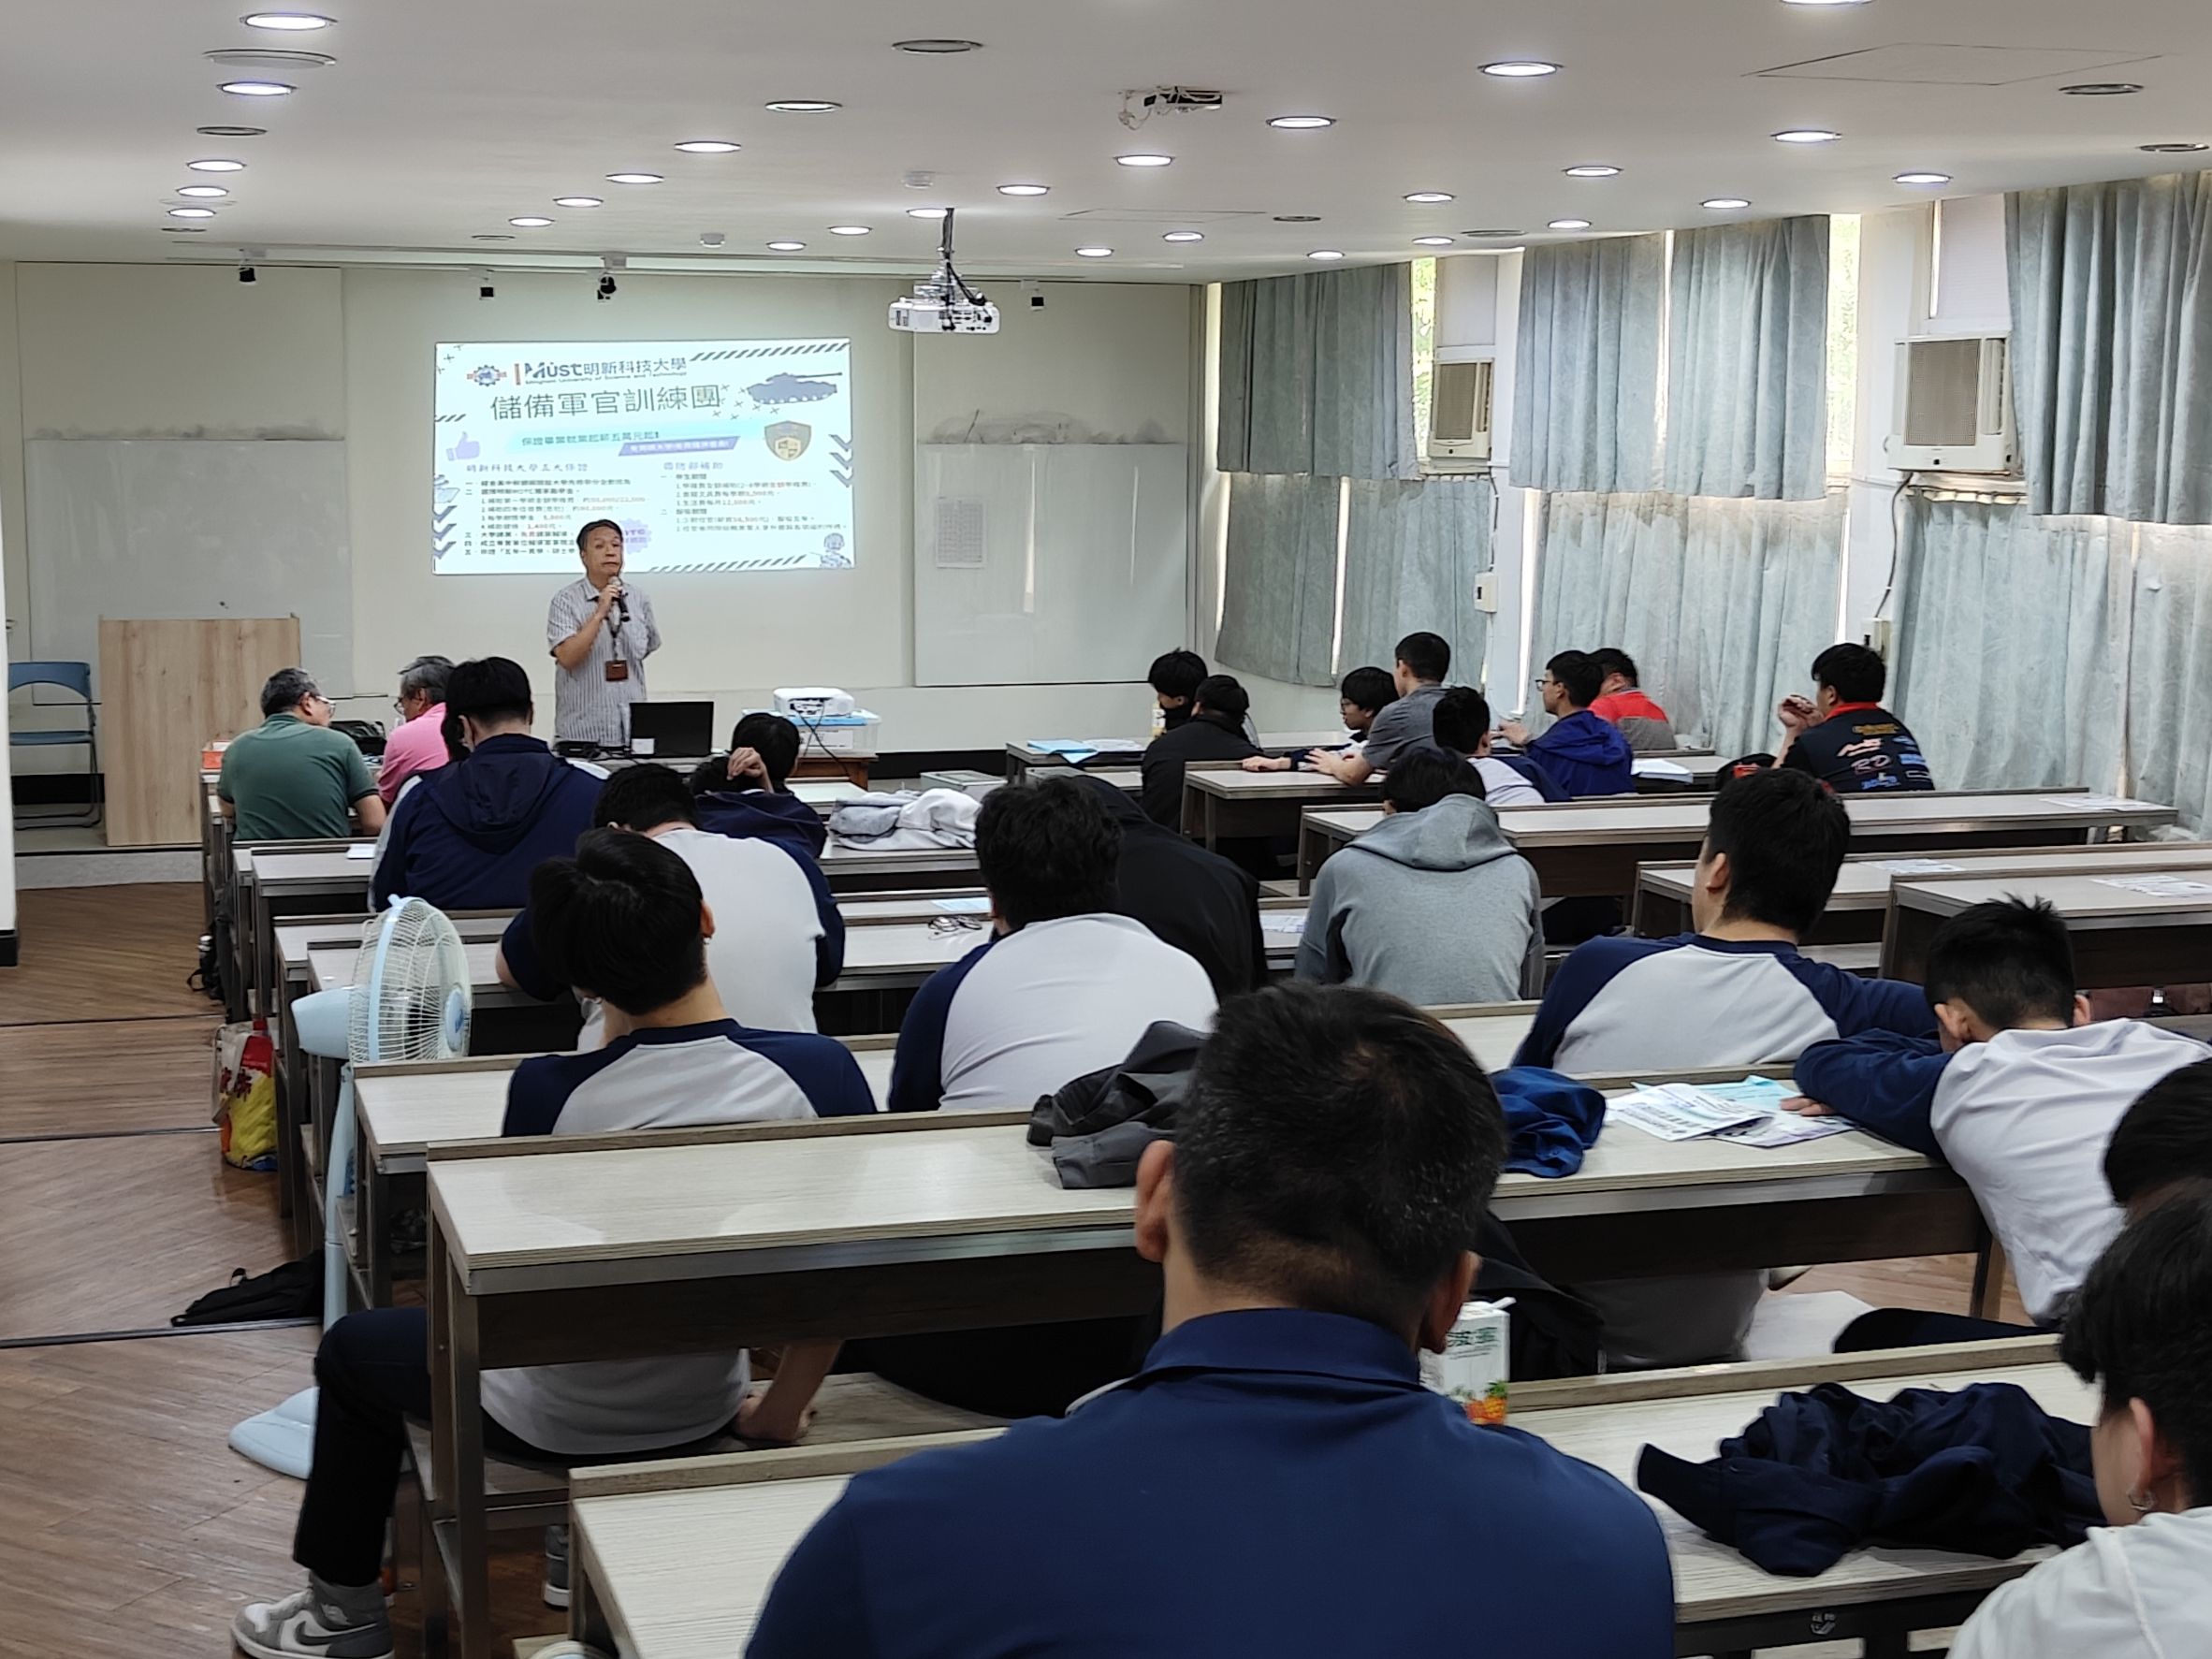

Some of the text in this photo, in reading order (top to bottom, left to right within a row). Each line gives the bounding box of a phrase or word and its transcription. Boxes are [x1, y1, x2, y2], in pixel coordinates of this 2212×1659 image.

[583, 357, 687, 376] 明新科技大學
[490, 384, 720, 421] 儲備軍官訓練團
